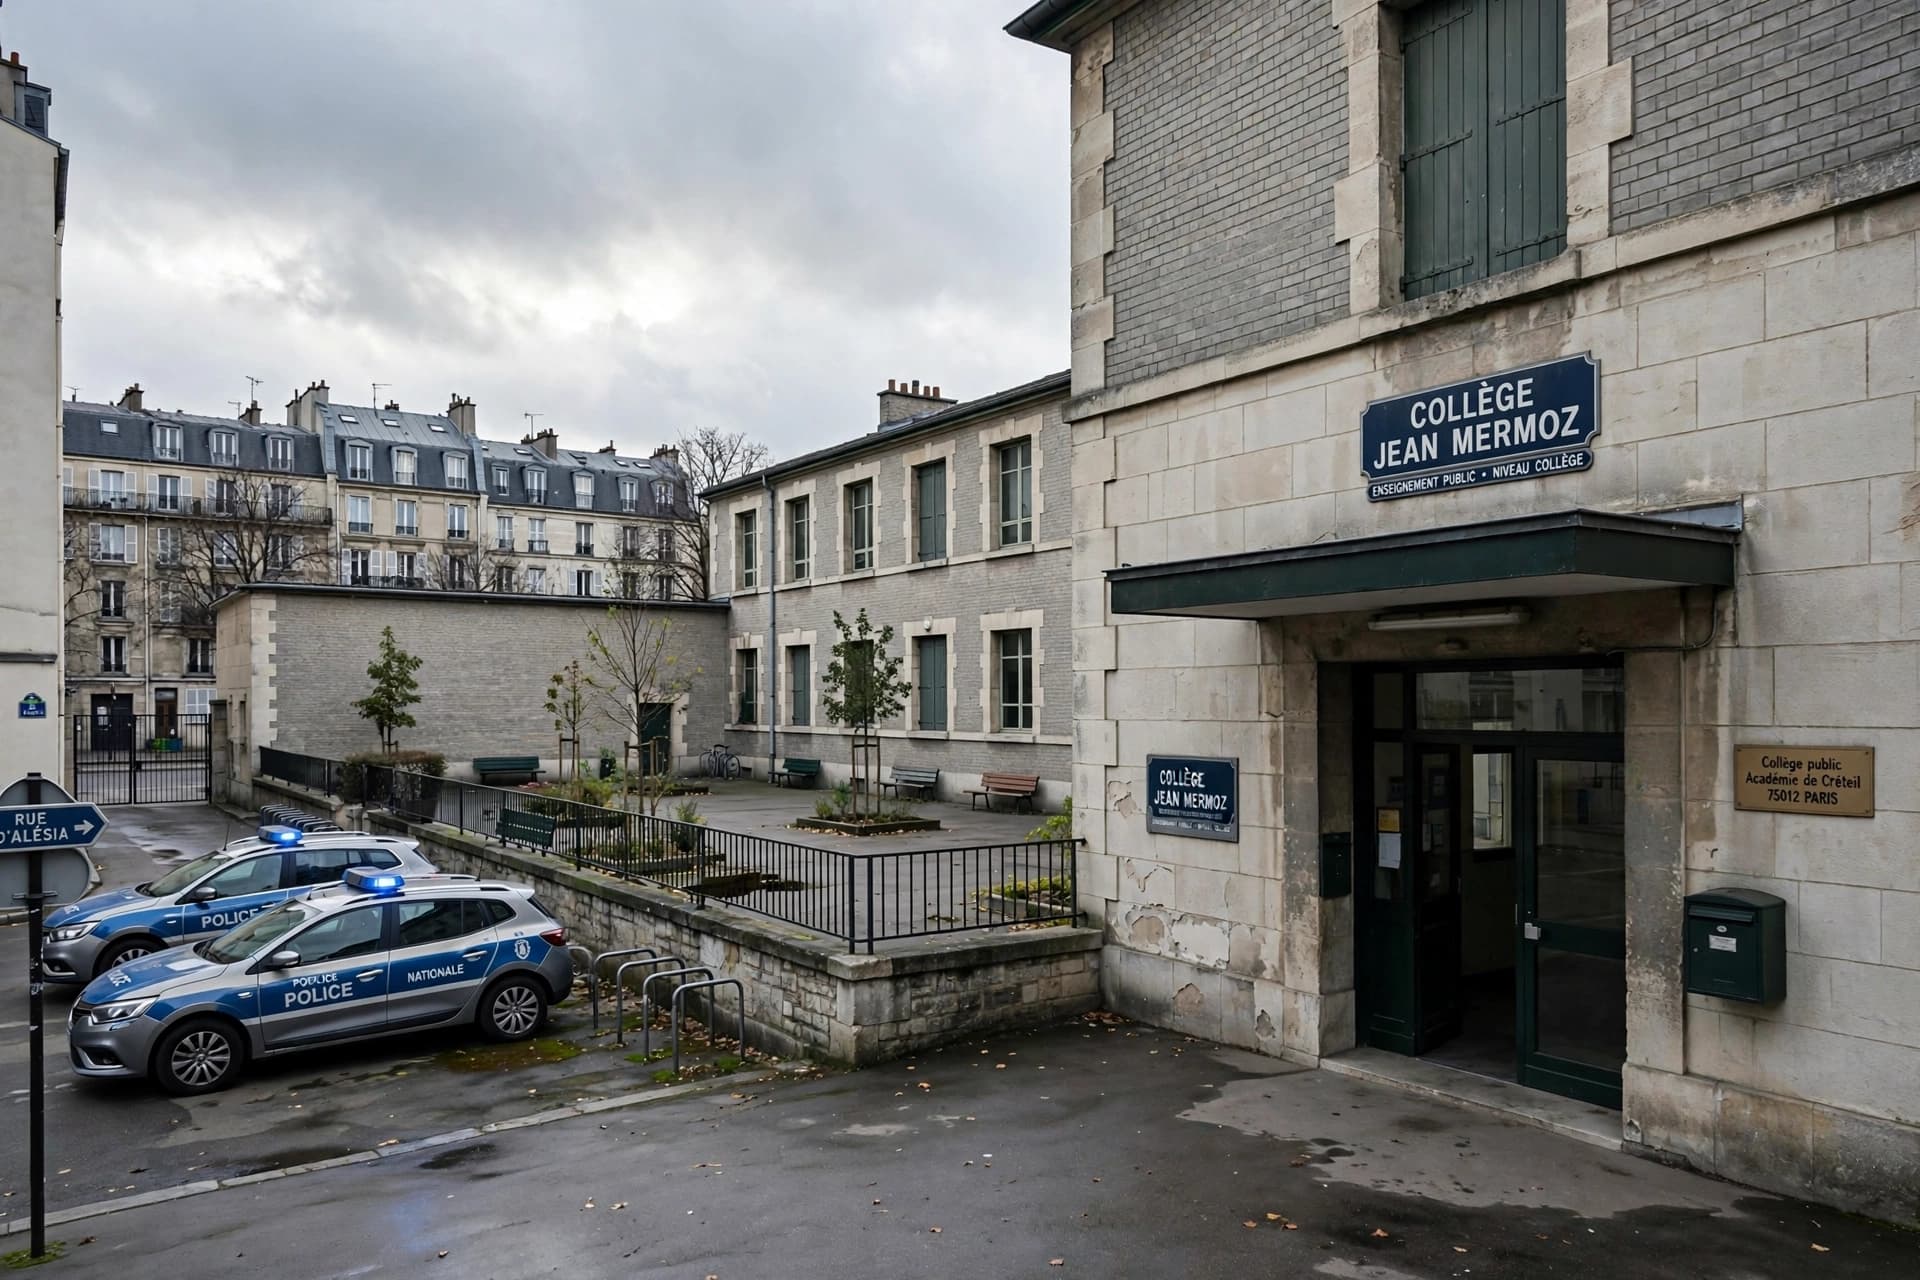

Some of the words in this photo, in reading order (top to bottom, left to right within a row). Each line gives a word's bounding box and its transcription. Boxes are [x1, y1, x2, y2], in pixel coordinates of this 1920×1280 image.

[1410, 377, 1534, 429] COLLÈGE
[1373, 431, 1438, 470] JEAN
[1452, 404, 1580, 456] MERMOZ
[1372, 477, 1439, 497] ENSEIGNEMENT
[1442, 470, 1476, 486] PUBLIC
[1492, 462, 1530, 479] NIVEAU
[1535, 453, 1584, 472] COLLÈGE
[1761, 756, 1803, 772] Collège
[1807, 757, 1842, 771] public
[1160, 766, 1206, 788] COLLÈGE
[1745, 772, 1798, 786] Académie
[1803, 774, 1817, 786] de
[1822, 774, 1861, 789] Créteil
[1154, 790, 1180, 807] JEAN
[1184, 791, 1227, 810] MERMOZ
[1767, 788, 1800, 803] 75012
[1804, 791, 1838, 805] PARIS
[15, 812, 47, 826] RUE
[285, 982, 353, 1008] POLICE
[407, 963, 464, 984] NATIONALE
